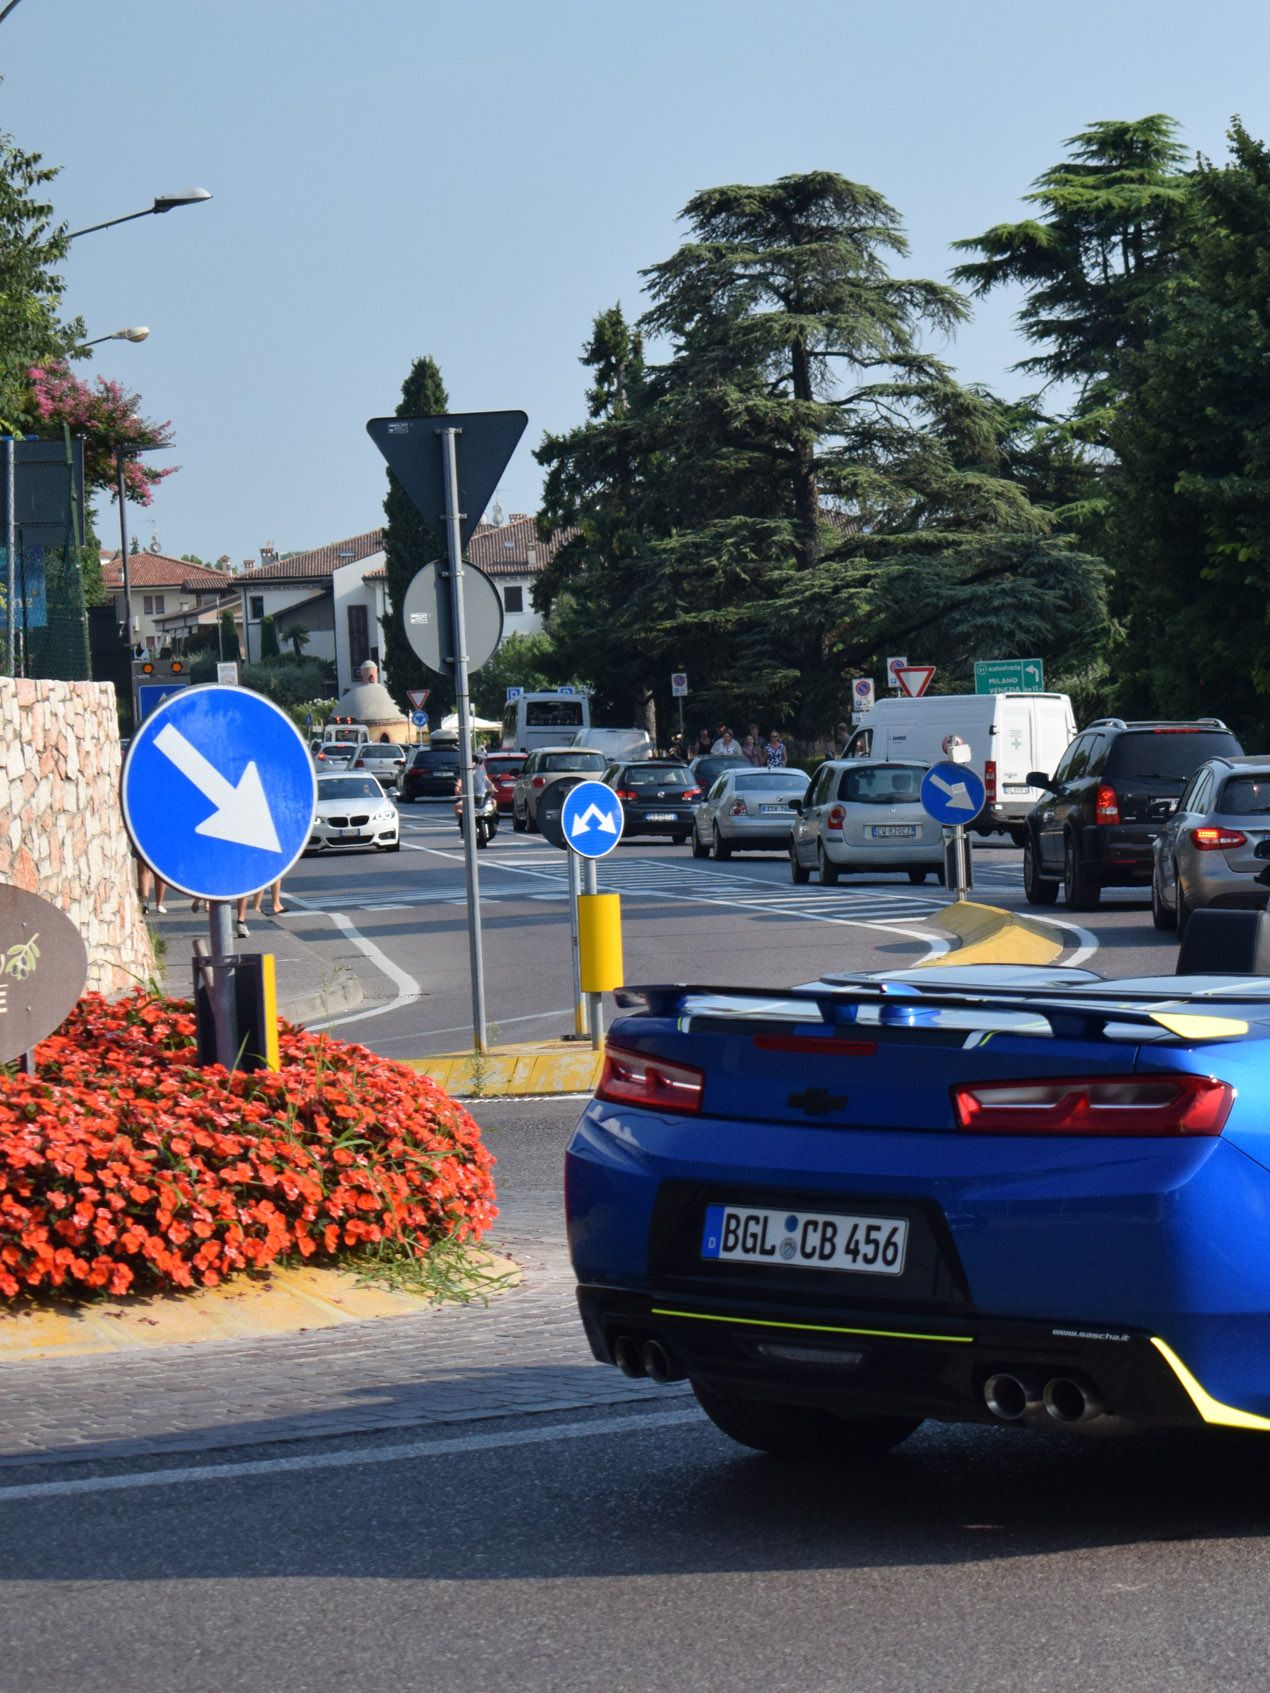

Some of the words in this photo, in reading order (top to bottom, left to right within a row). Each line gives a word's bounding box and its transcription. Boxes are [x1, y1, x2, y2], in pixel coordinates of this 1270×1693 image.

[989, 677, 1018, 685] MILANO
[989, 686, 1020, 694] VENEZIA
[708, 1237, 717, 1249] D
[722, 1213, 776, 1256] BGL
[800, 1219, 838, 1261] CB
[844, 1223, 900, 1267] 456
[1052, 1328, 1131, 1342] www.sascha.it
